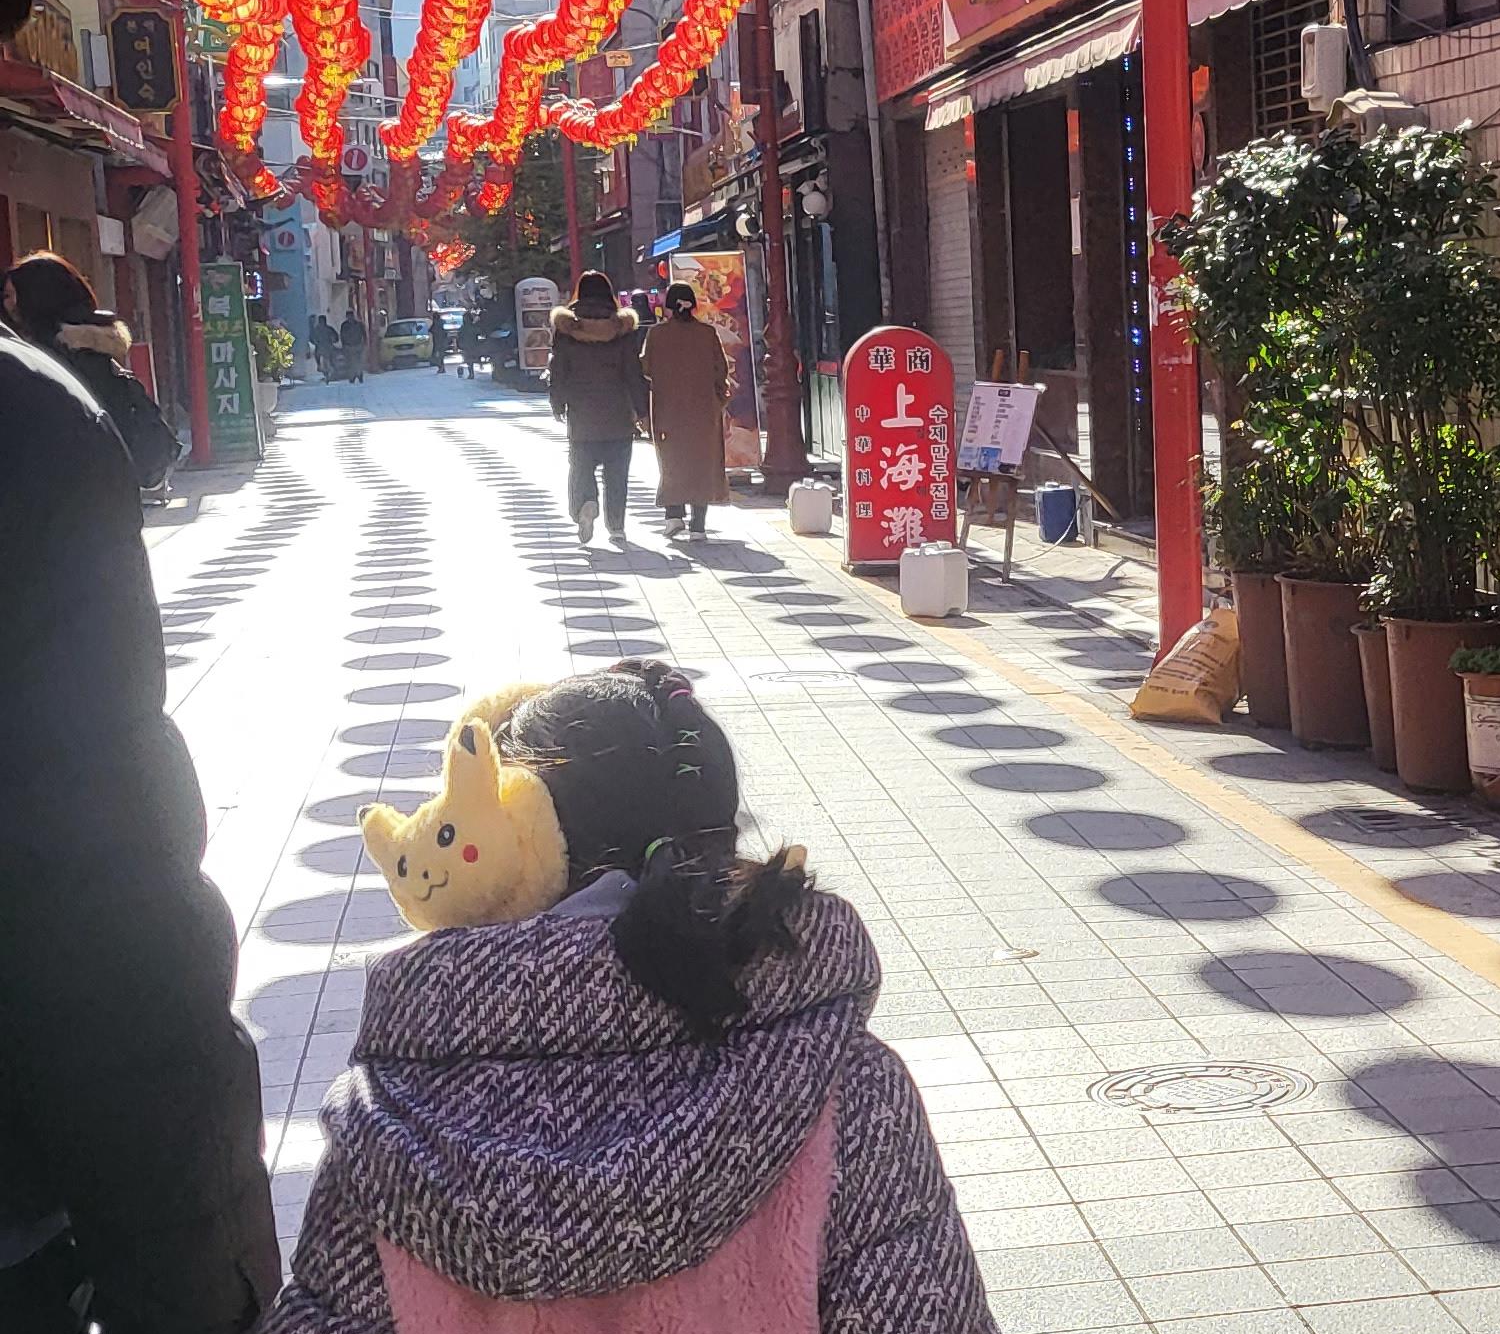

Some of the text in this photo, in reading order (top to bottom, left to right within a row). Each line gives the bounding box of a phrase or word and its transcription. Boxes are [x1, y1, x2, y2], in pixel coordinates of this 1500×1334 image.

[211, 340, 240, 415] 마사지
[855, 405, 873, 519] 中華料理
[880, 382, 930, 548] 上海灘
[929, 405, 949, 520] 수제만두전문
